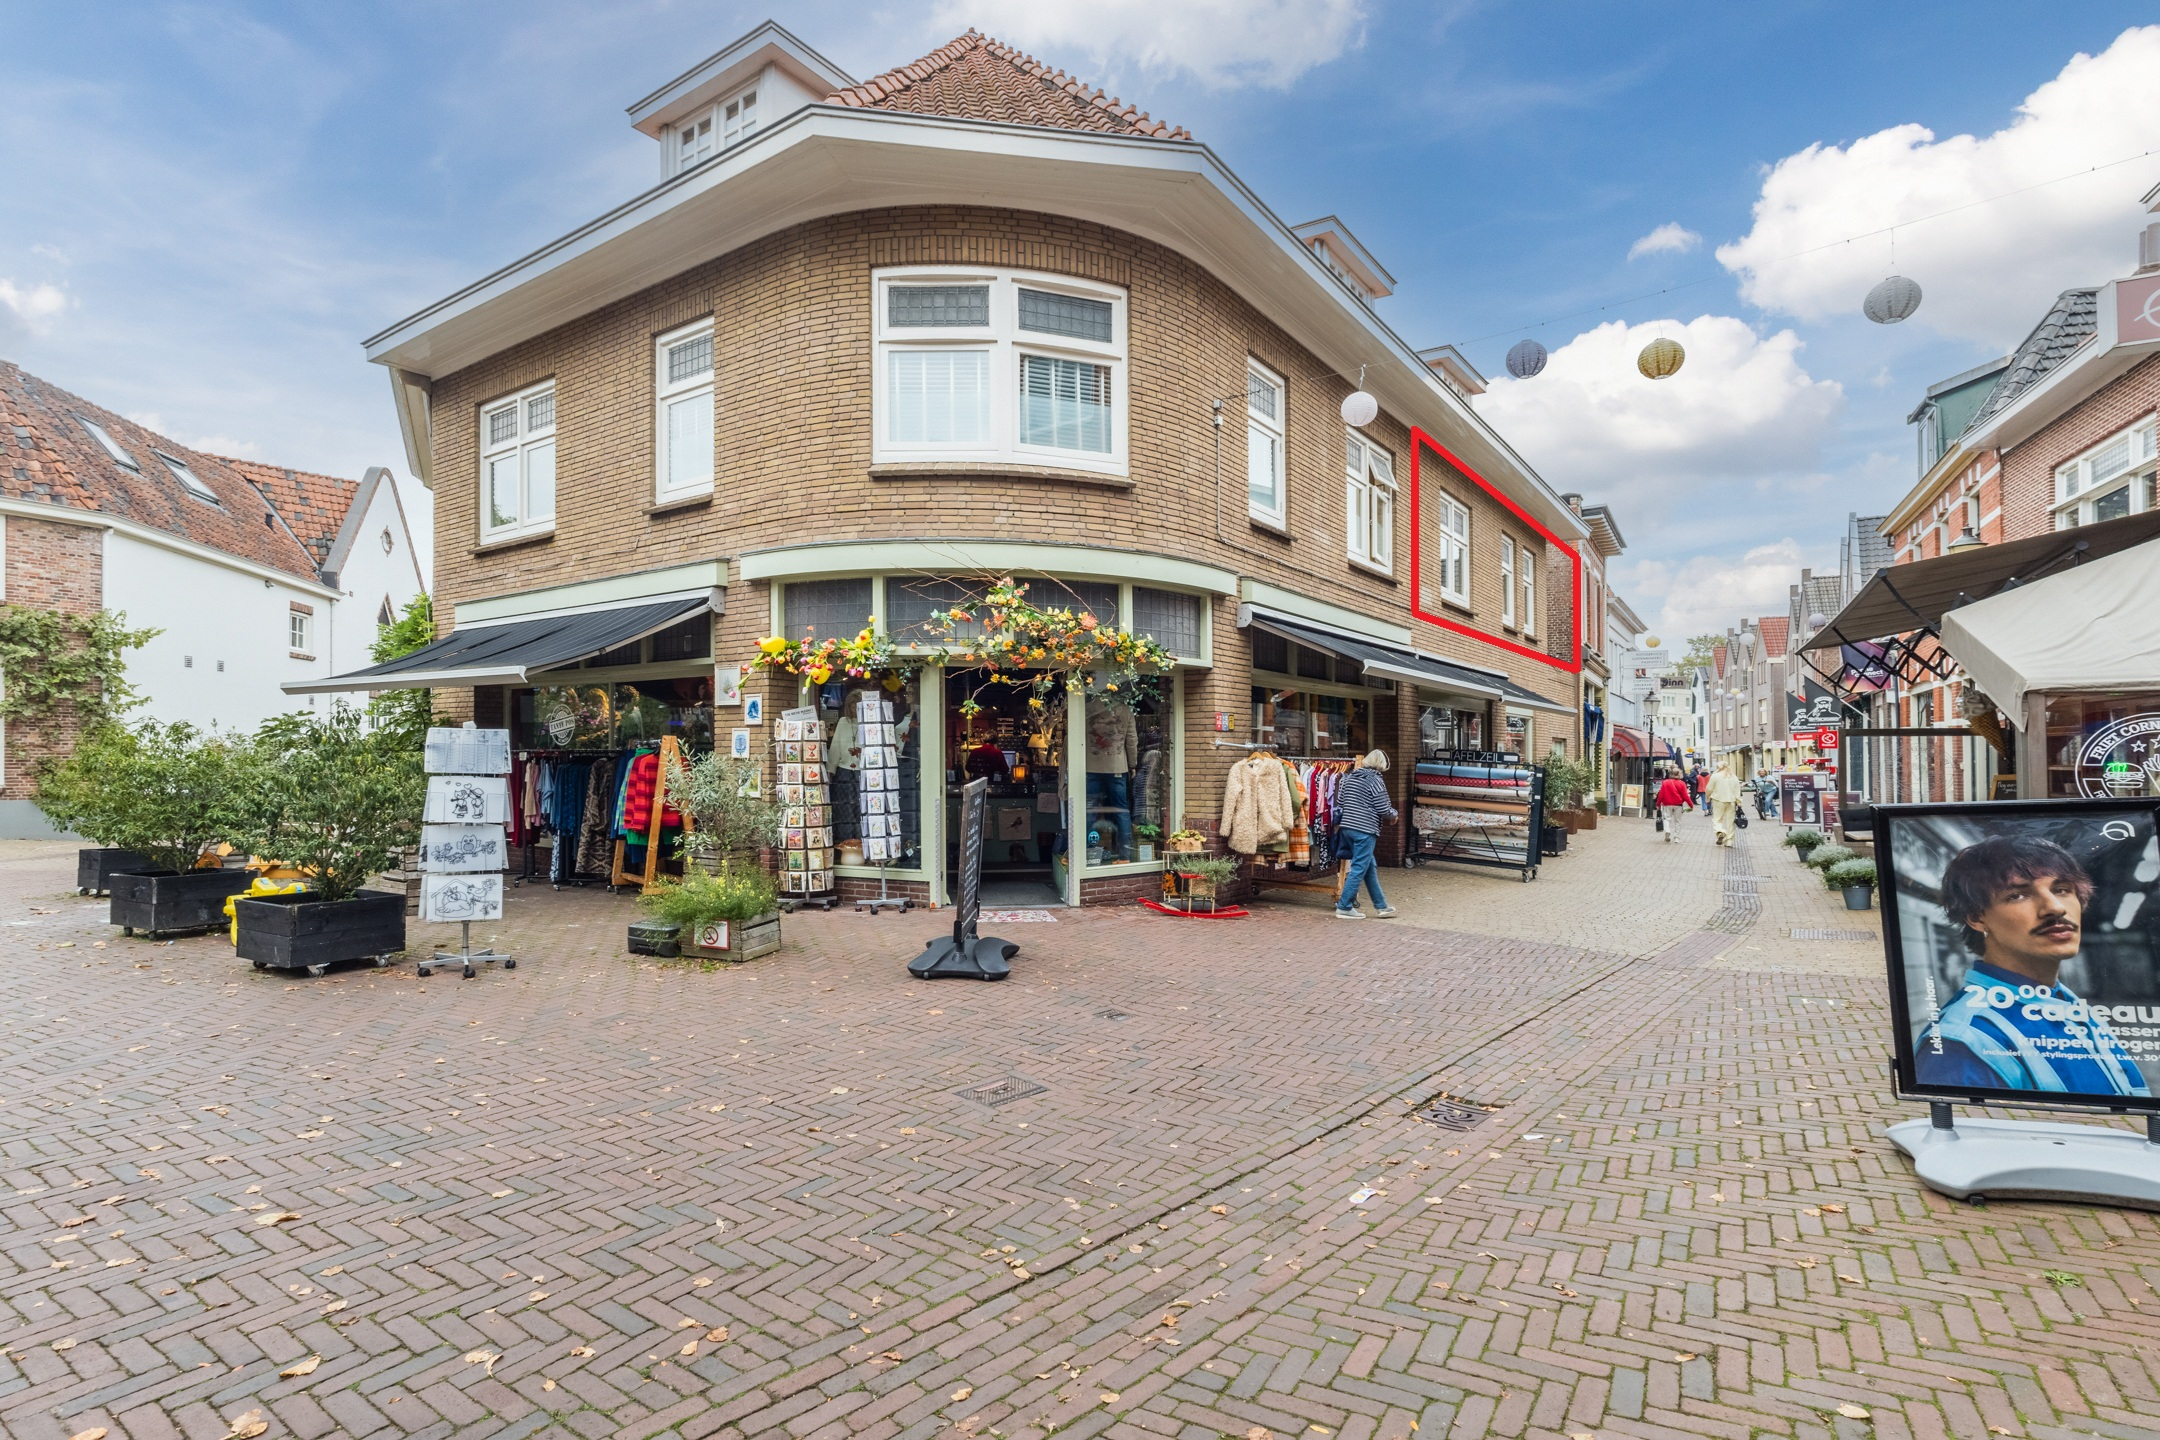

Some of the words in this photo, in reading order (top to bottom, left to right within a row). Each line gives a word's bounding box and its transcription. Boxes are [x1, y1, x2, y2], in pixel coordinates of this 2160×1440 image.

[2090, 732, 2121, 760] FRIET
[1925, 976, 1937, 1001] haar.
[1926, 1001, 1941, 1012] je
[2021, 998, 2160, 1024] cadeau
[1928, 1012, 1940, 1022] in
[1929, 1021, 1944, 1055] Lekker
[2063, 1025, 2089, 1038] op
[2018, 1034, 2095, 1050] knippen
[1983, 1048, 2021, 1057] inclusief
